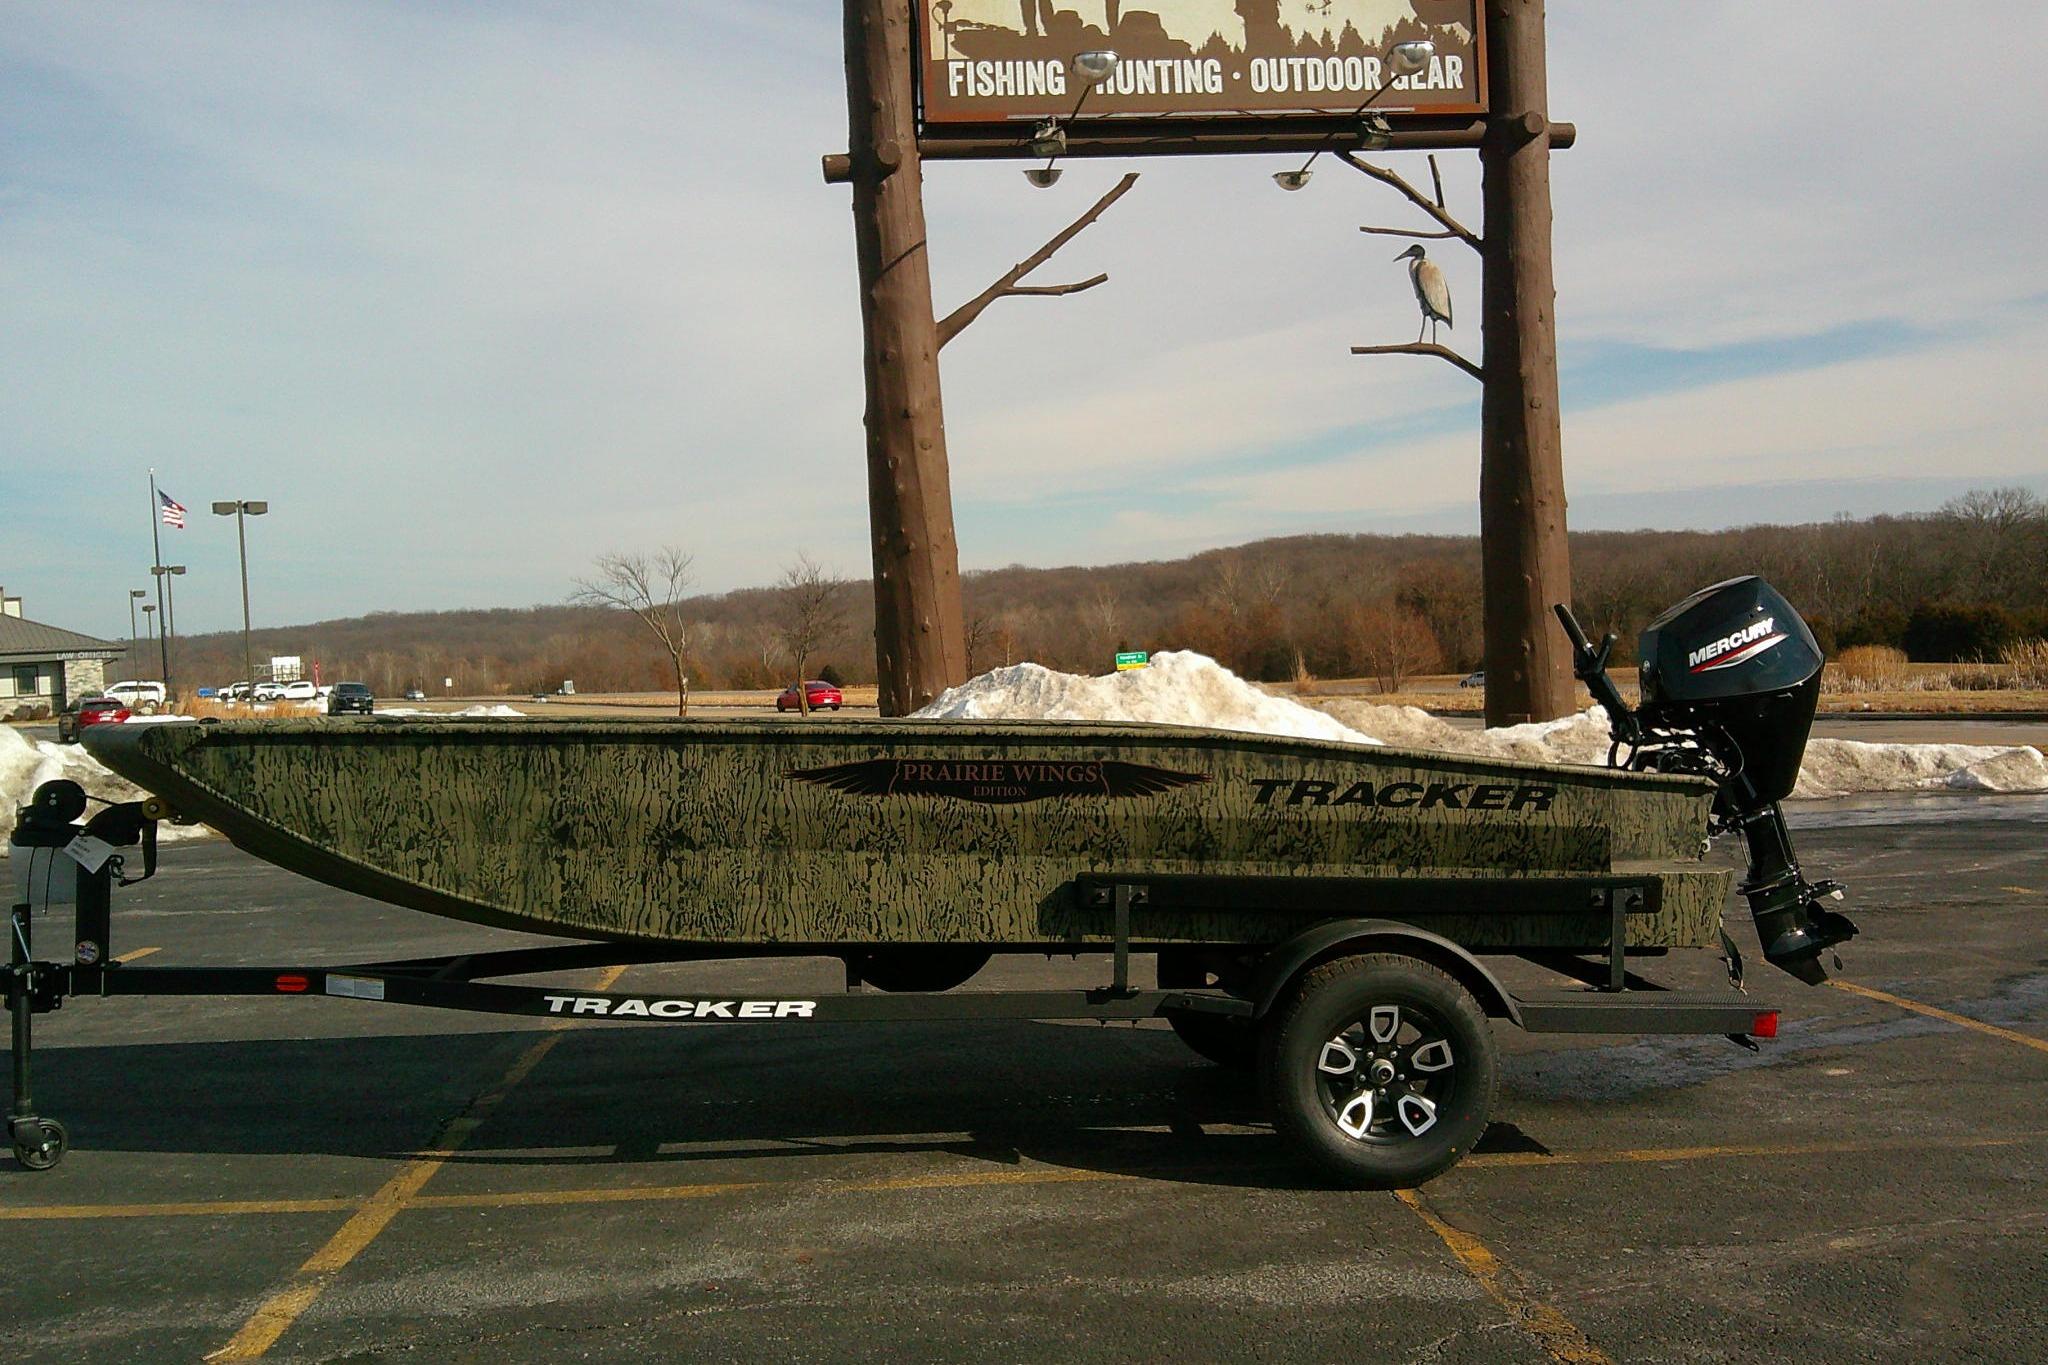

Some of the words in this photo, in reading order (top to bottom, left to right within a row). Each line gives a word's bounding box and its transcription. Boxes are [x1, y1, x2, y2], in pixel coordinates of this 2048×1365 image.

[948, 59, 1066, 97] FISHING
[1095, 57, 1223, 95] UNTING
[1250, 56, 1382, 92] OUTDOOR
[1689, 617, 1775, 668] MERCURY
[56, 652, 74, 660] LAW
[903, 764, 1005, 782] PRAIRIE
[1011, 764, 1098, 783] WINGS
[973, 786, 1027, 797] EDITION
[1249, 779, 1558, 811] TRACKER
[543, 996, 816, 1018] TRACKER
